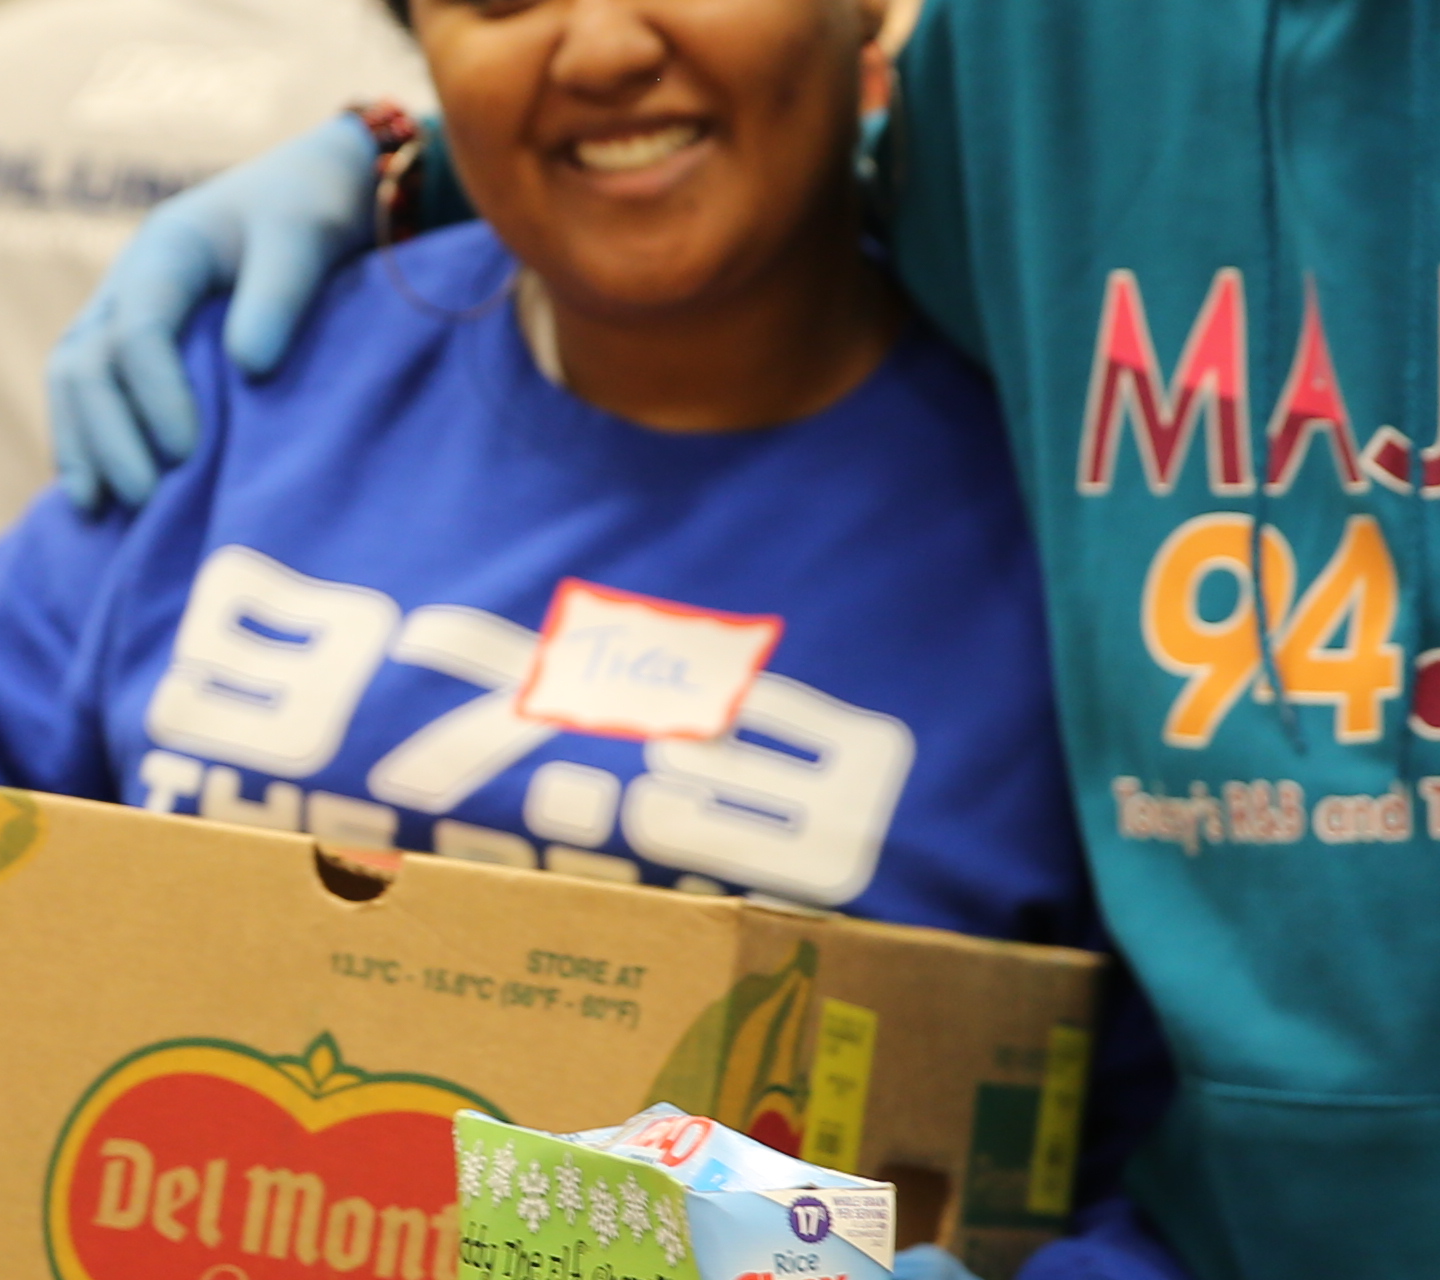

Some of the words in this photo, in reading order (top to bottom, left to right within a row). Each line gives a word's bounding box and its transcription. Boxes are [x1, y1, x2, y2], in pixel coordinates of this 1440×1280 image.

[146, 543, 916, 907] 97.9
[1314, 779, 1412, 844] and
[526, 949, 609, 984] STORE
[615, 965, 646, 989] AT
[94, 1139, 223, 1246] Del
[773, 1250, 819, 1274] Rice
